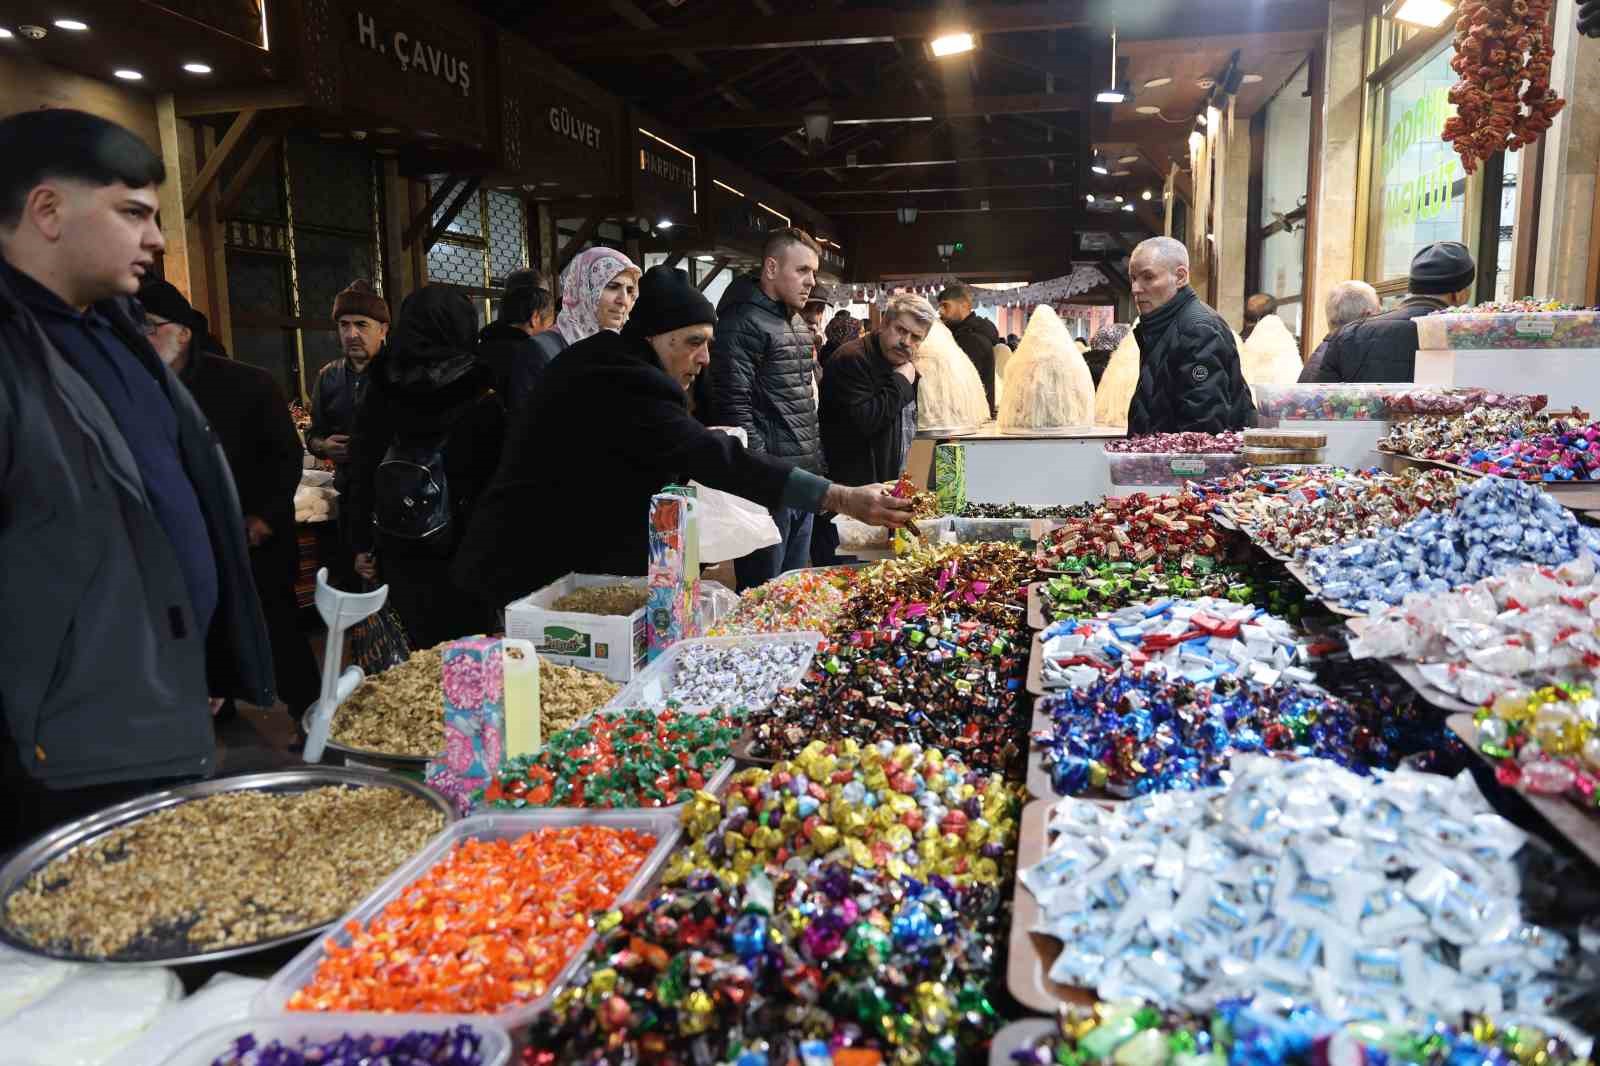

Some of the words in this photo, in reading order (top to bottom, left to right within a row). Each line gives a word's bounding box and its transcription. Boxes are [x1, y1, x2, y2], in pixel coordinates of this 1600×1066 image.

[357, 11, 385, 54] H.
[394, 31, 470, 97] ÇAVUŞ
[549, 106, 601, 150] GÜLVET
